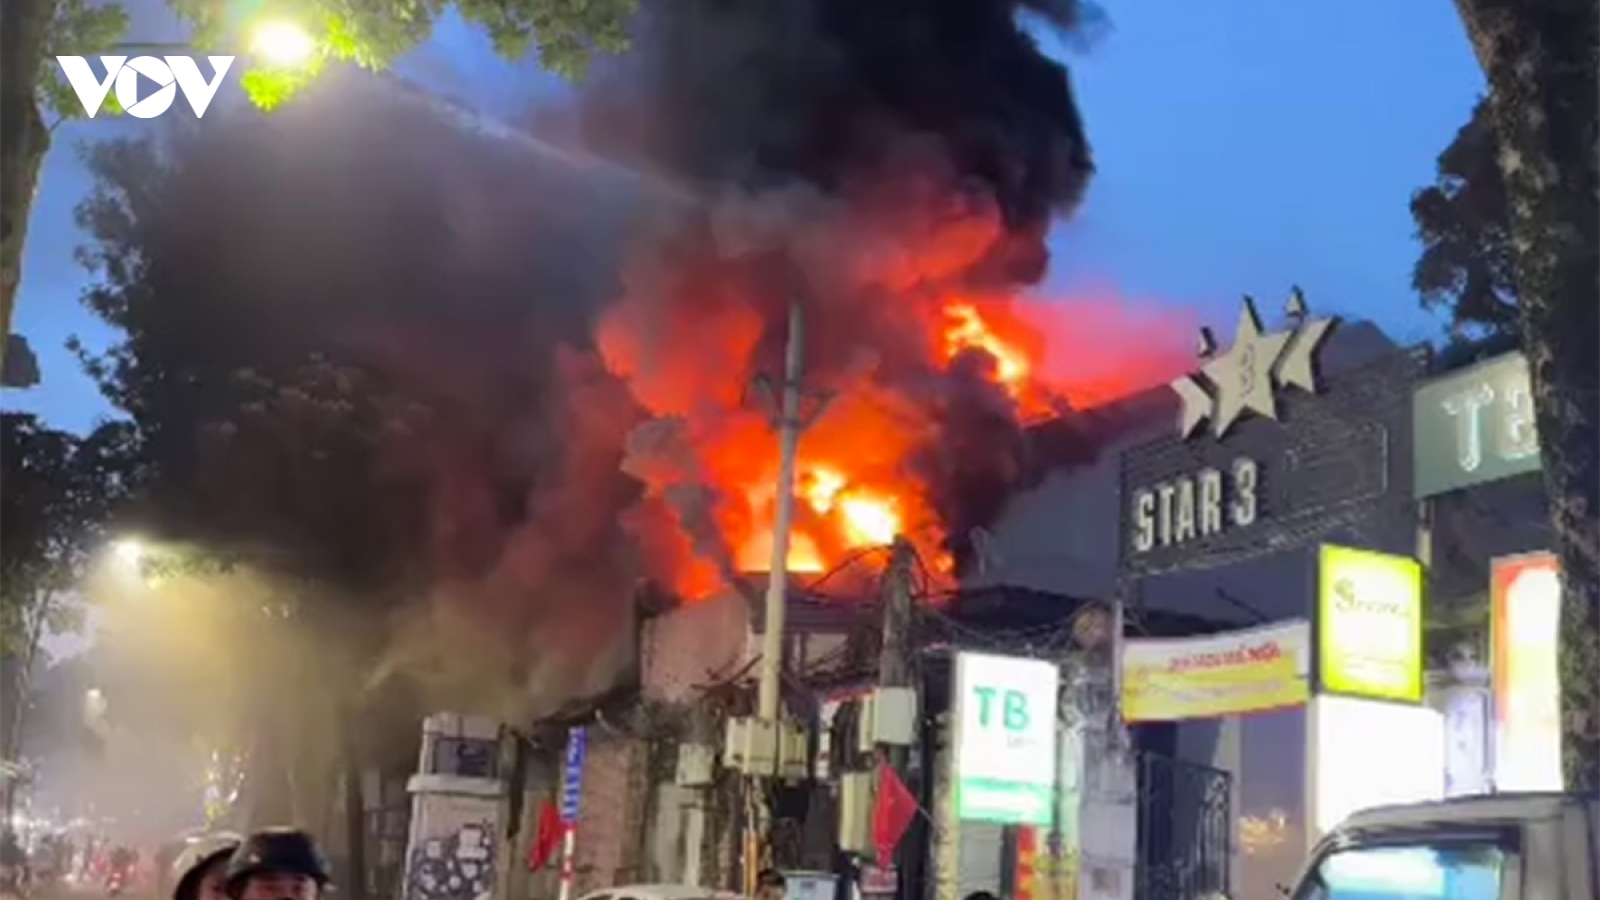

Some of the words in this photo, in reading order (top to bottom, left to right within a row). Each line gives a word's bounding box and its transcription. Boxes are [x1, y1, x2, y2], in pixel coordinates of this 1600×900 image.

[1133, 468, 1221, 552] STAR
[1232, 457, 1257, 526] 3
[972, 685, 1031, 732] TB
